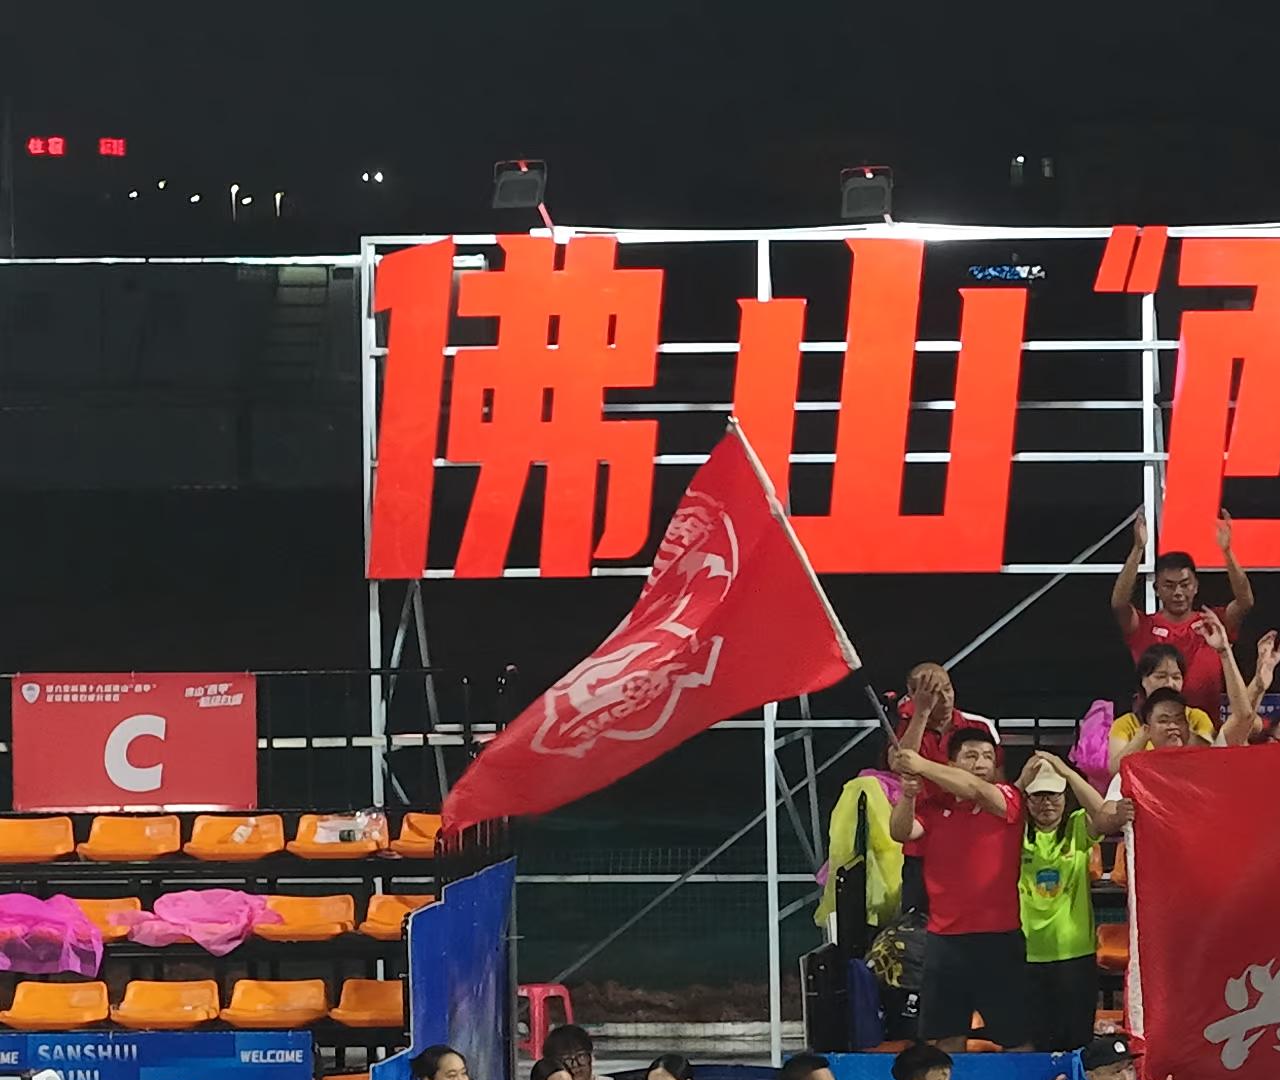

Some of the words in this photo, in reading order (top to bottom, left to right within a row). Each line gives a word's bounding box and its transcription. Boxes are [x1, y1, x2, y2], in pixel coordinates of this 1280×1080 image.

[104, 714, 166, 792] C
[38, 1045, 138, 1062] SANSHUI
[240, 1050, 304, 1064] WELCOME
